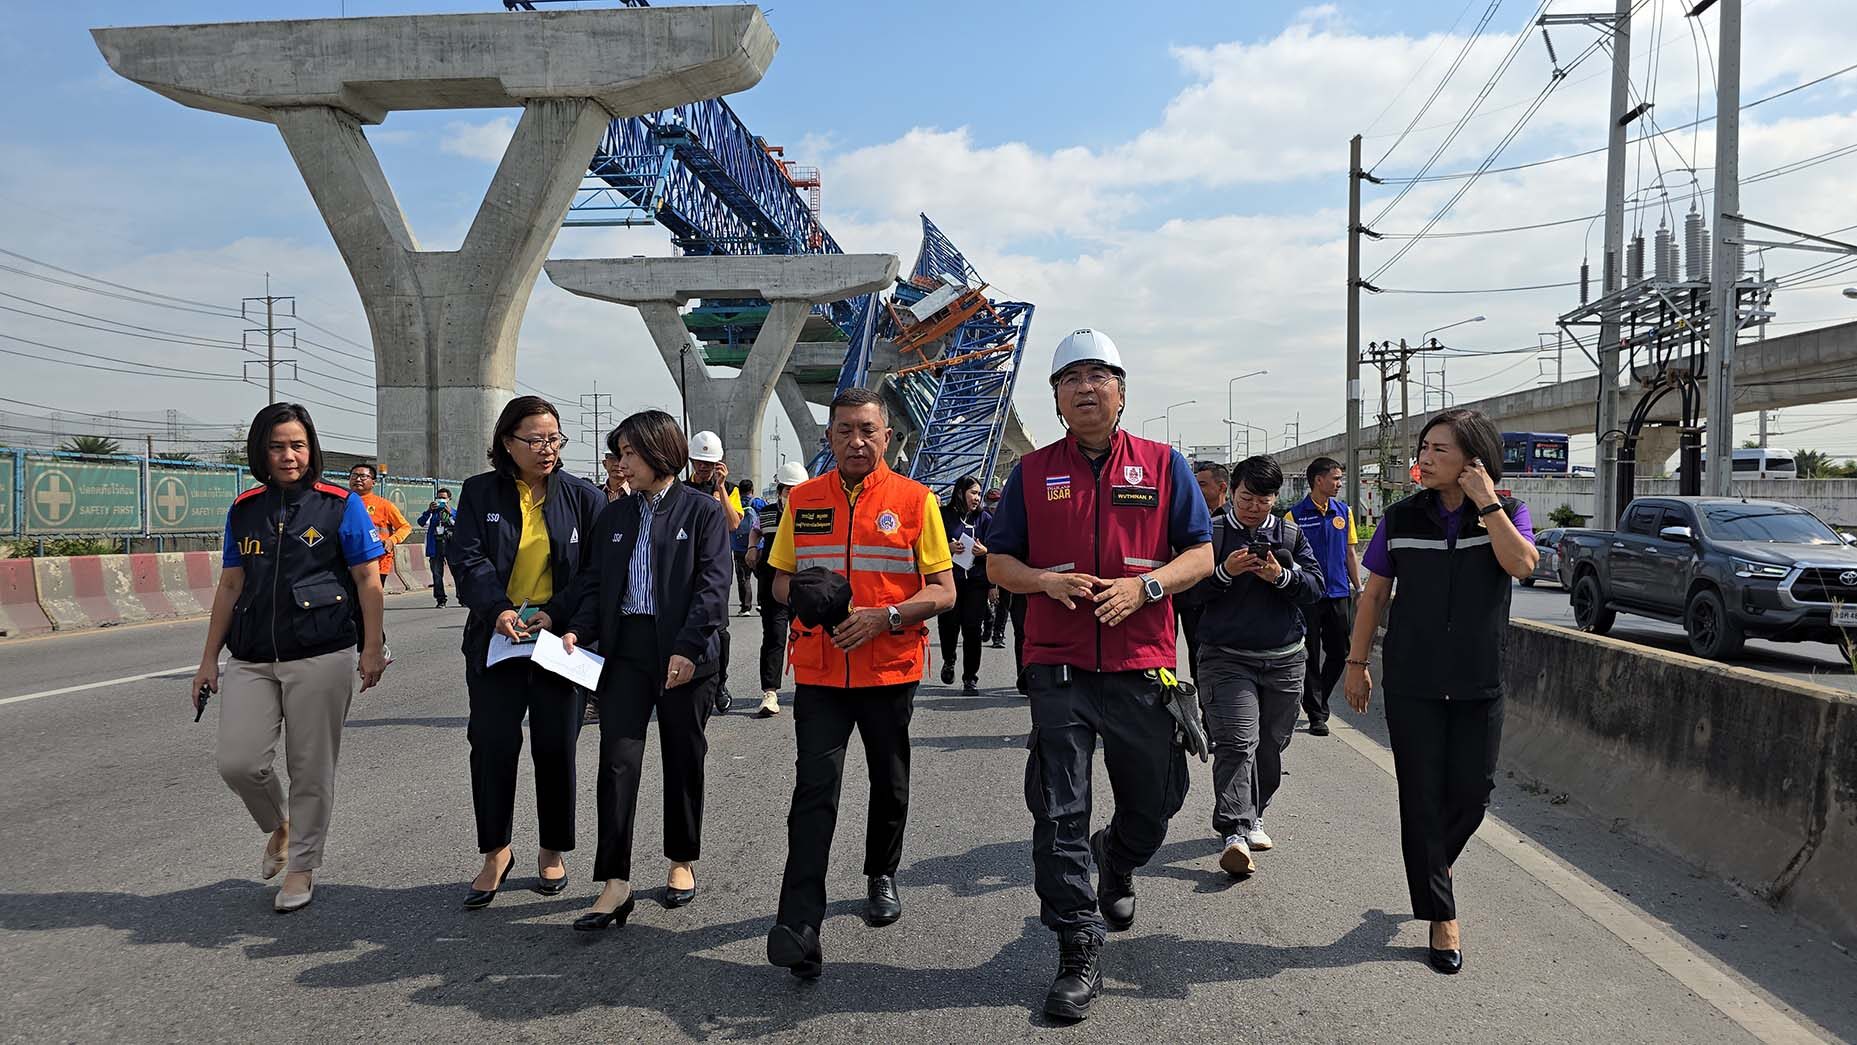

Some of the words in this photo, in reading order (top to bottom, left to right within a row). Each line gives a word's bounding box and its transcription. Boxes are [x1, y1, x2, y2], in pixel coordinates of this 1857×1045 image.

[1047, 488, 1071, 501] USAR
[79, 505, 109, 515] SAFETY
[111, 505, 135, 515] FIRST
[191, 507, 214, 516] SAFETY
[486, 513, 500, 522] SSO
